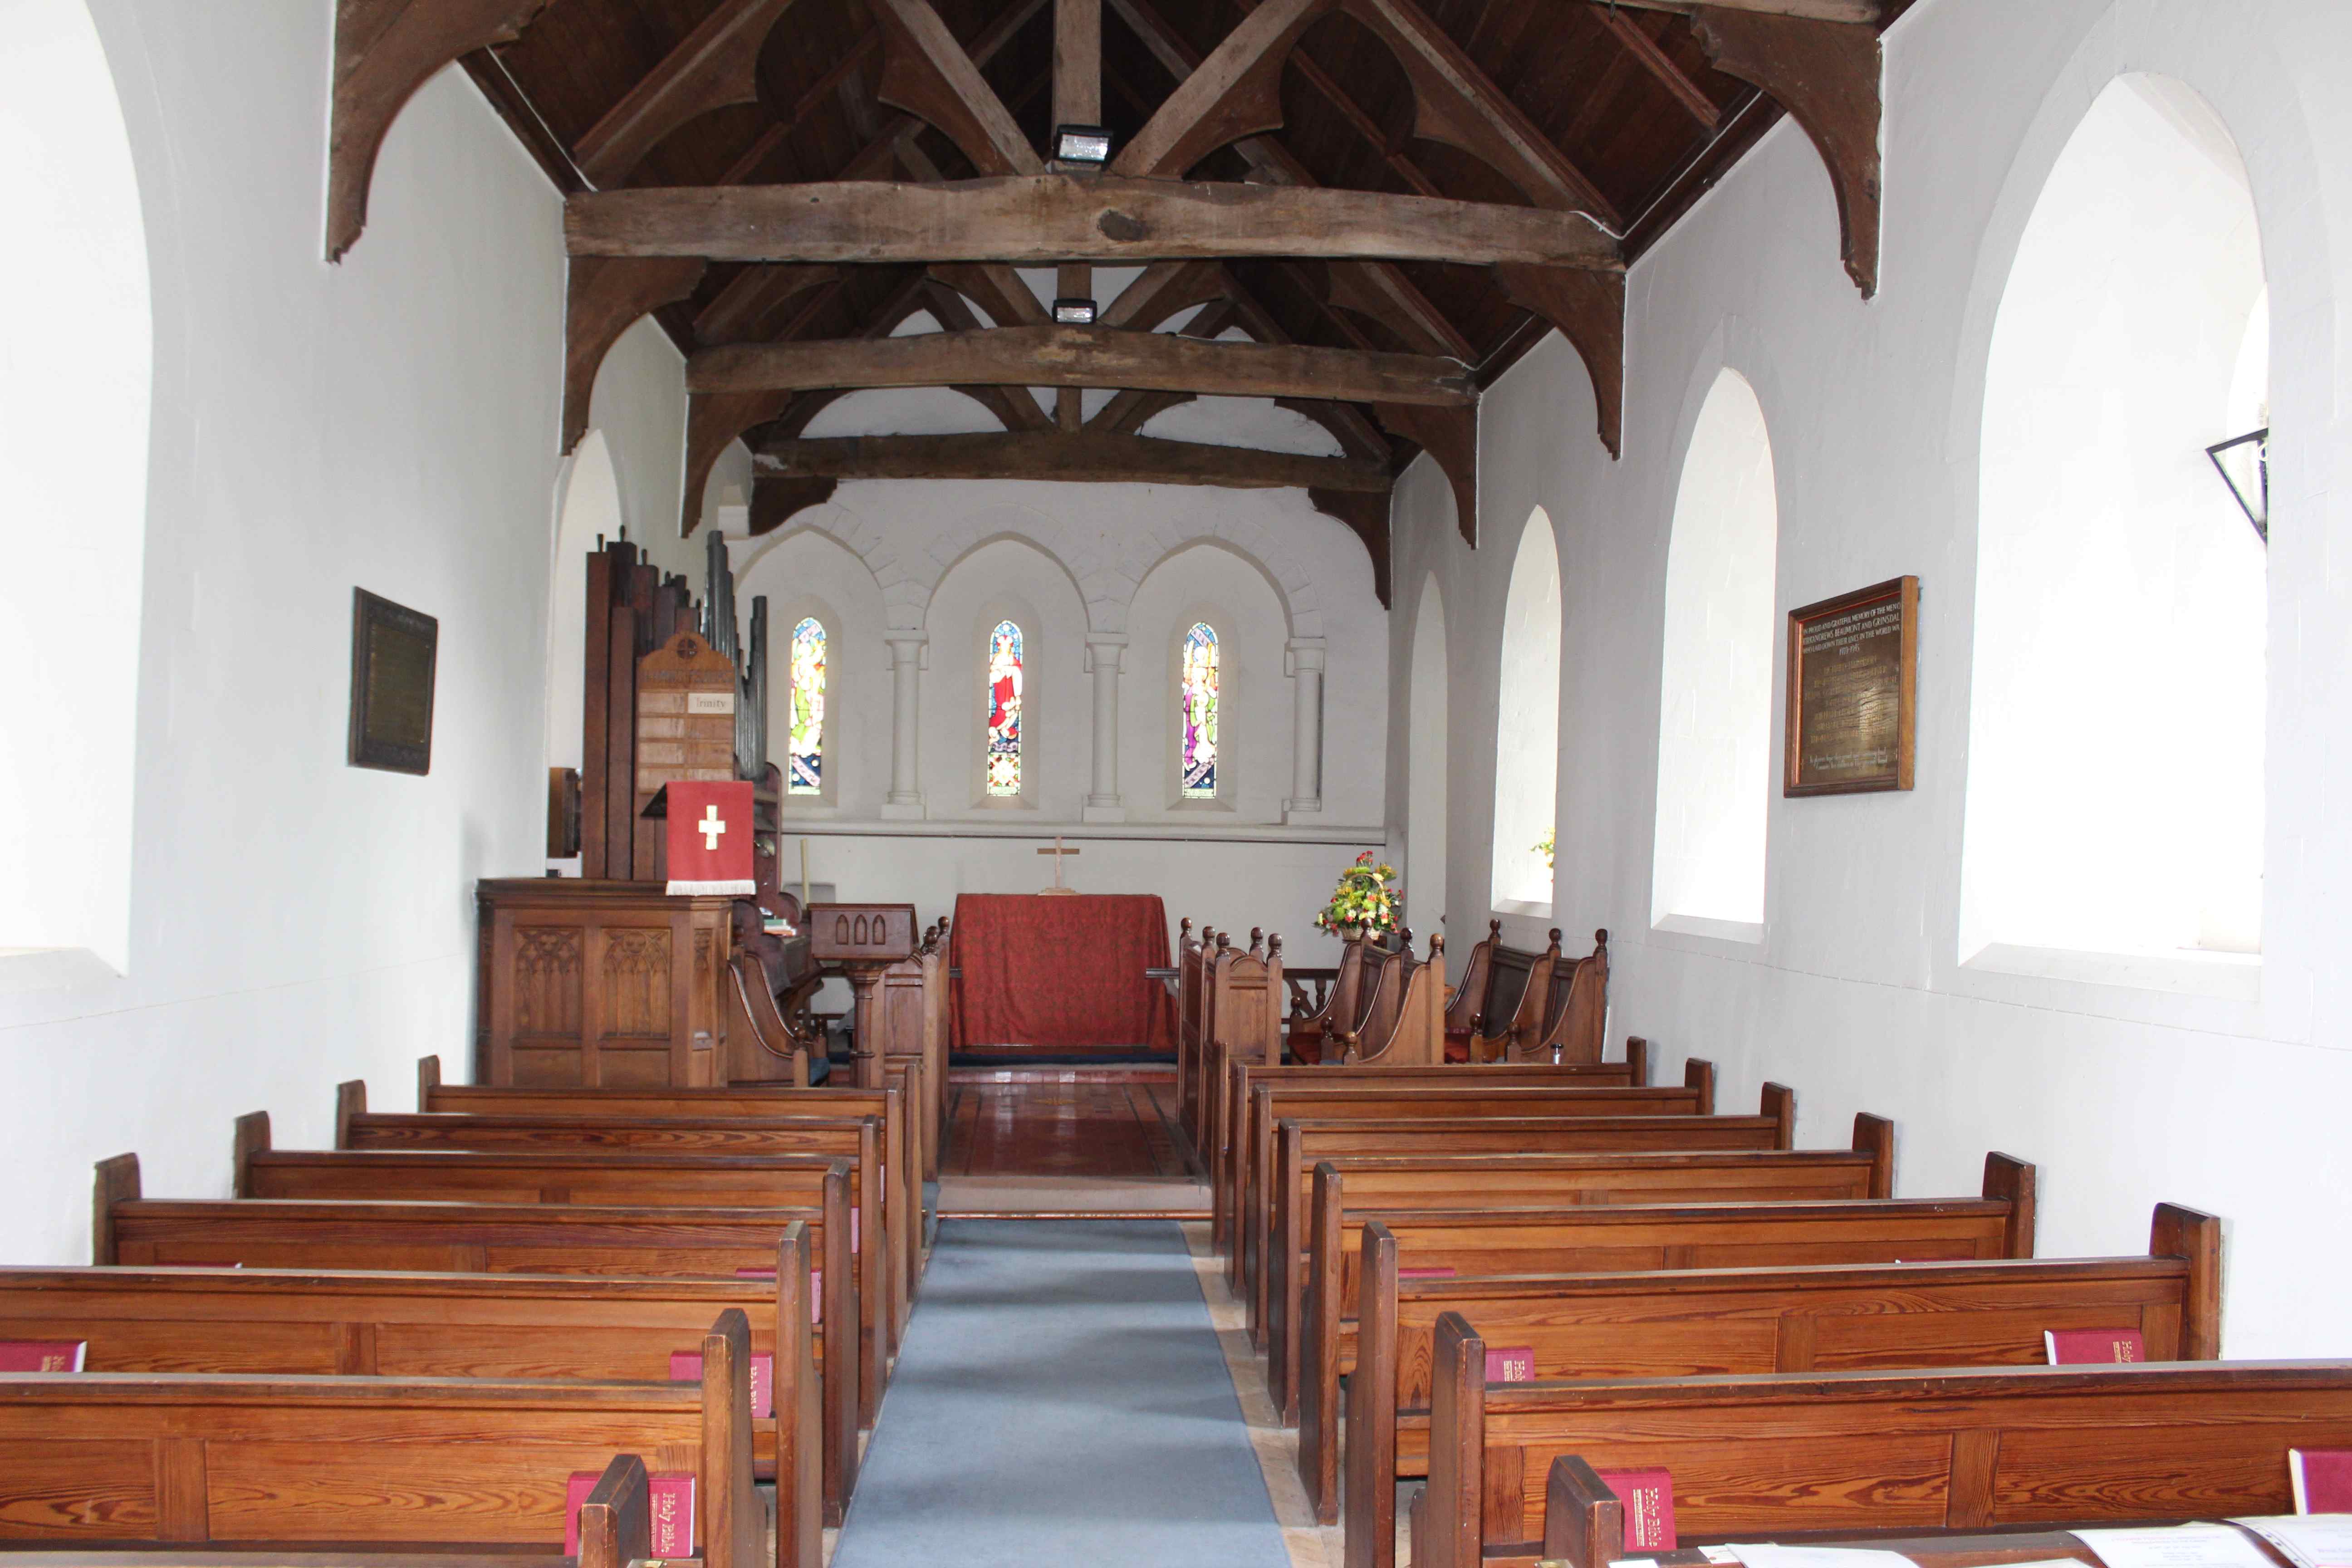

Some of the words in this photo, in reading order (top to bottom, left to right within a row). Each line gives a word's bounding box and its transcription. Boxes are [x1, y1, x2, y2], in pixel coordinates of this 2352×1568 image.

[1822, 622, 1831, 630] AND
[1831, 616, 1851, 628] GRATEFUL
[1852, 611, 1870, 622] MEMORY
[1870, 608, 1877, 617] OF
[1877, 606, 1886, 615] THE
[1886, 603, 1897, 612] MEN
[1834, 622, 1861, 637] BEAUMONT
[1861, 620, 1872, 630] AND
[1872, 612, 1900, 627] GRINSDAL
[1836, 636, 1847, 646] THEIR
[1848, 634, 1859, 643] LIVES
[1865, 630, 1875, 639] THE
[1875, 626, 1891, 636] WORLD
[658, 1493, 675, 1522] Holy
[1643, 1488, 1659, 1517] Holy
[661, 1523, 675, 1553] Bible
[1647, 1518, 1661, 1547] Bible
